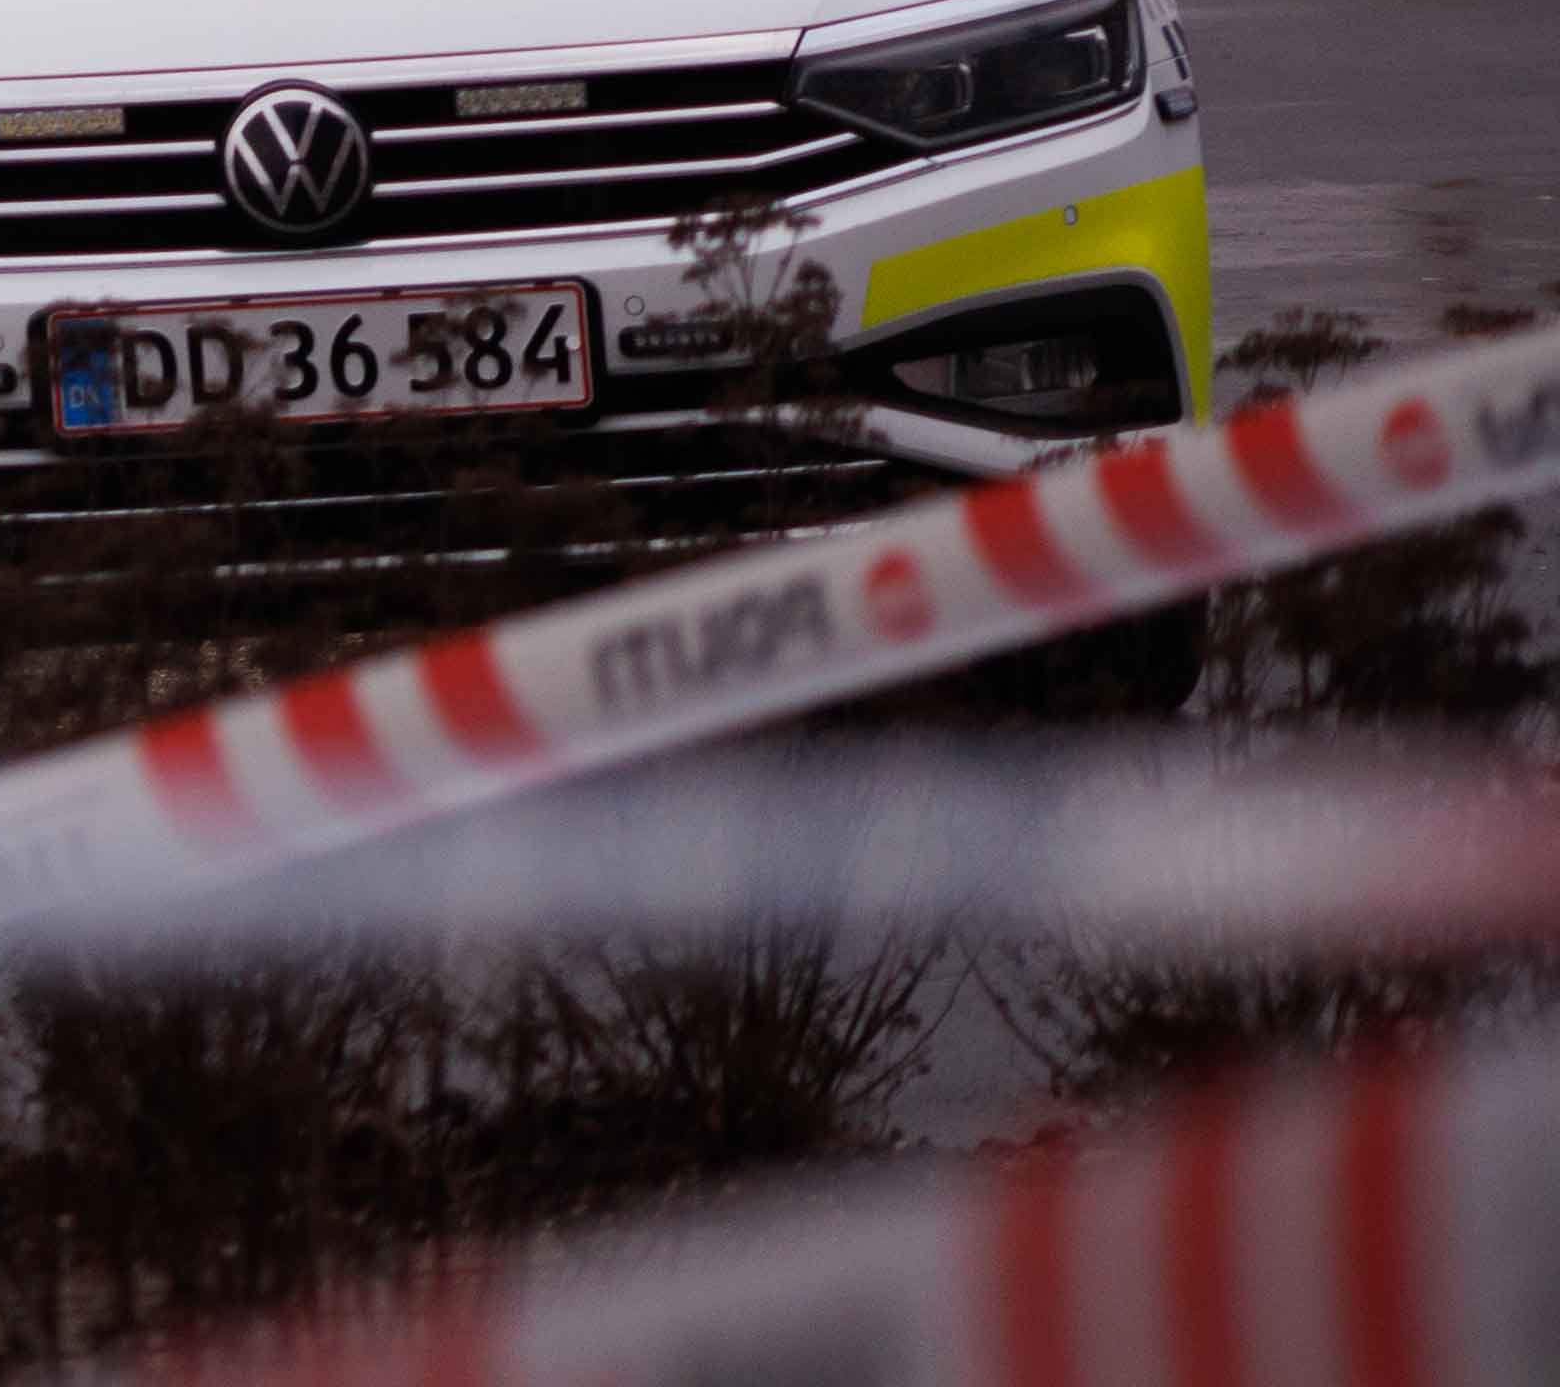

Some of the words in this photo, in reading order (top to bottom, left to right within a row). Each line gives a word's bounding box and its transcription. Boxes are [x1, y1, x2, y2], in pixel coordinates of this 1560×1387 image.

[122, 325, 245, 407] DD
[269, 313, 379, 401] 36
[407, 303, 572, 394] 584
